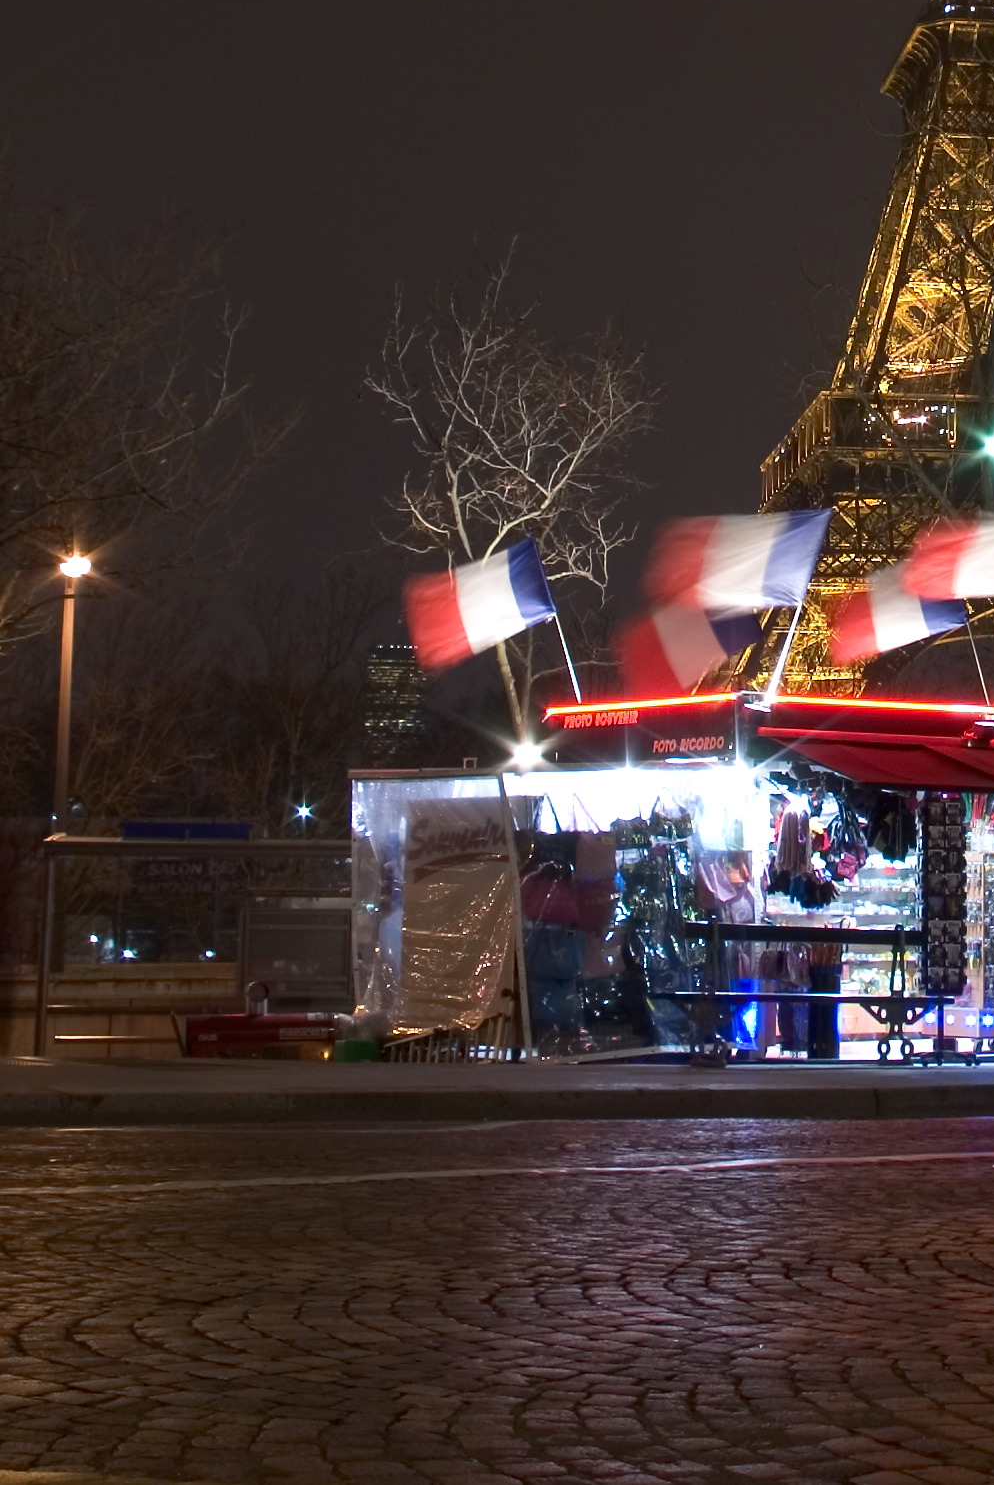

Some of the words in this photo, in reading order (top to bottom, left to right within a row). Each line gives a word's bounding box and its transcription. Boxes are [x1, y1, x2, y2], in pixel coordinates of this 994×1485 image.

[563, 715, 592, 728] PHOTO
[652, 738, 677, 753] FOTO
[679, 736, 725, 752] RICORDO
[147, 861, 204, 876] SALON
